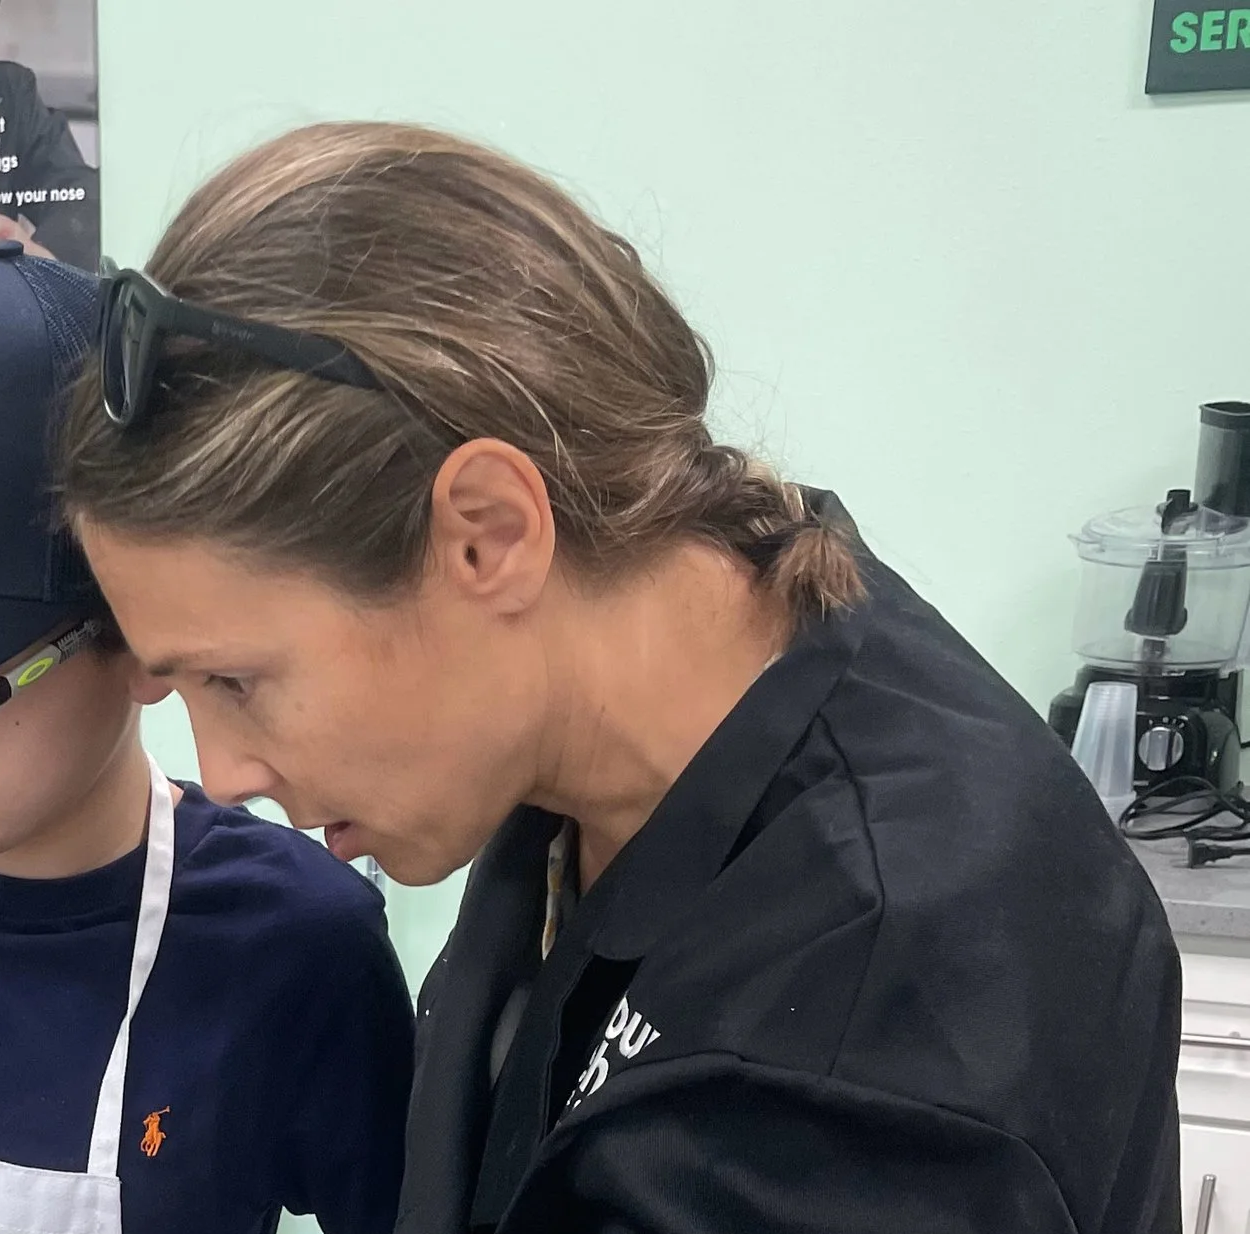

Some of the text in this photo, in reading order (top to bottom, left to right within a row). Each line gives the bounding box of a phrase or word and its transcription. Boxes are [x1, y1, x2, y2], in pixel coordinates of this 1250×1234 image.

[1170, 9, 1250, 53] SER
[16, 189, 48, 207] your
[50, 187, 86, 201] nose
